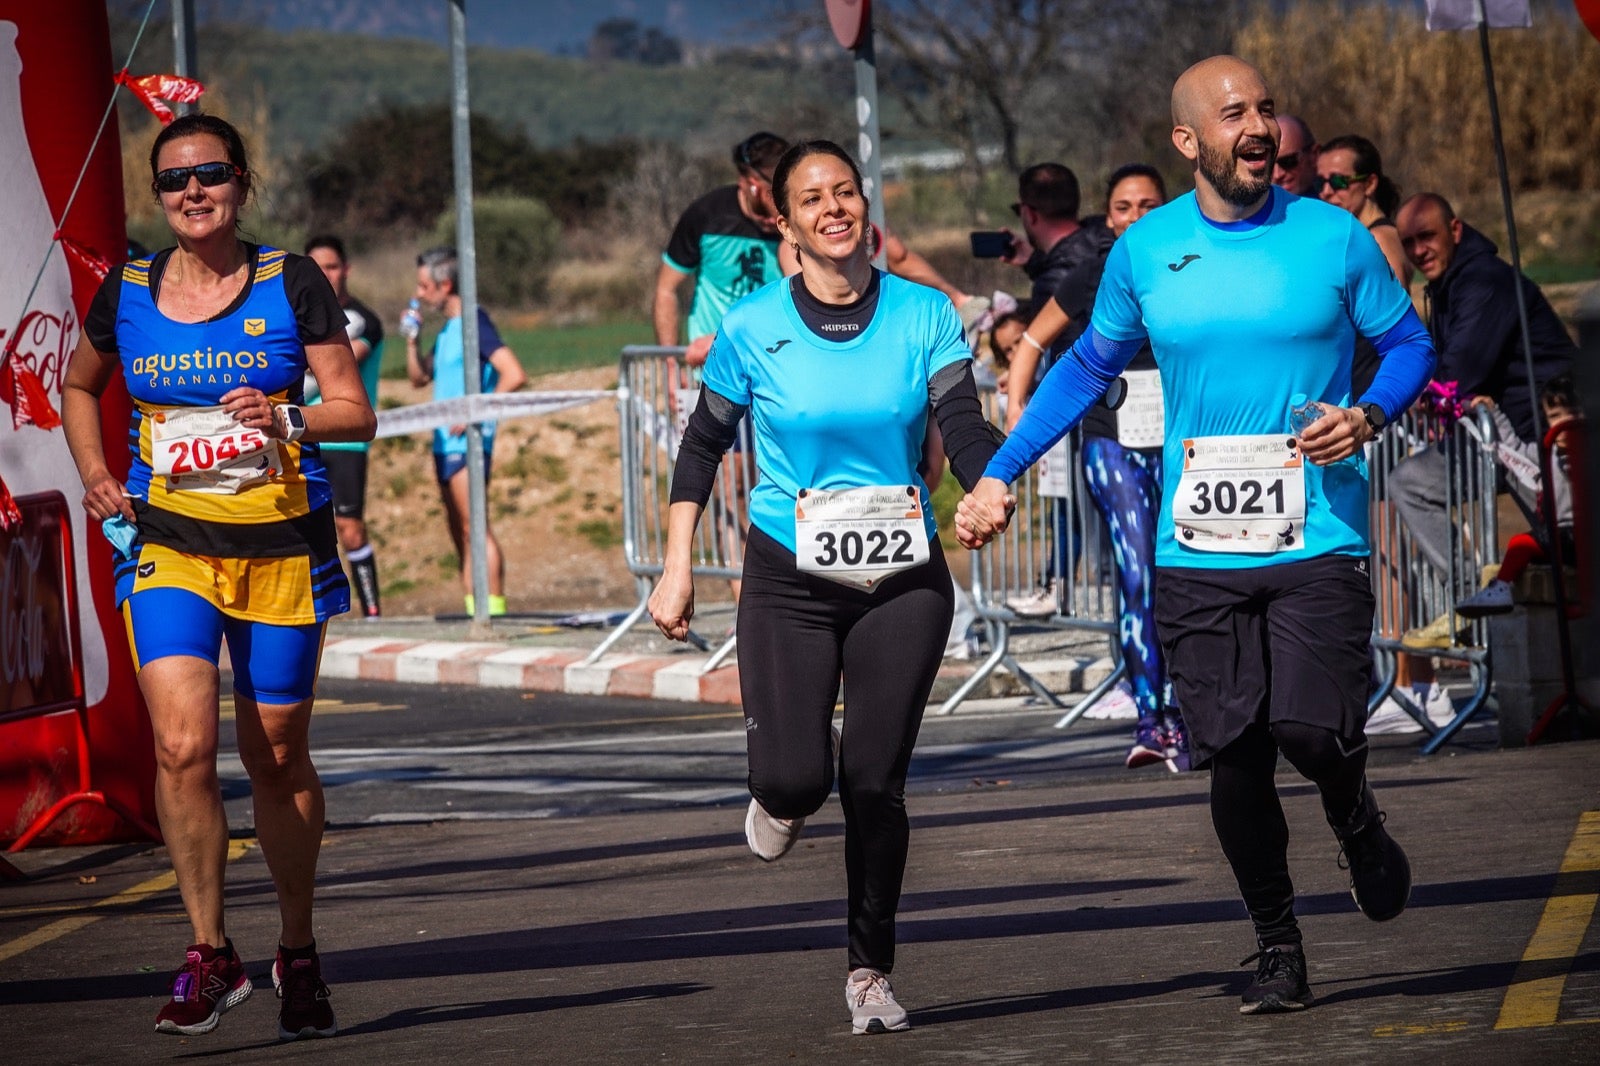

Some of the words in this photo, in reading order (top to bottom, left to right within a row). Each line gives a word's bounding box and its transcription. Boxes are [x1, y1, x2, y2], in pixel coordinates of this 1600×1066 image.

[132, 346, 269, 379] agustinos
[149, 373, 248, 388] GRANADA
[168, 430, 264, 475] 2045
[1189, 479, 1285, 515] 3021
[814, 529, 914, 566] 3022
